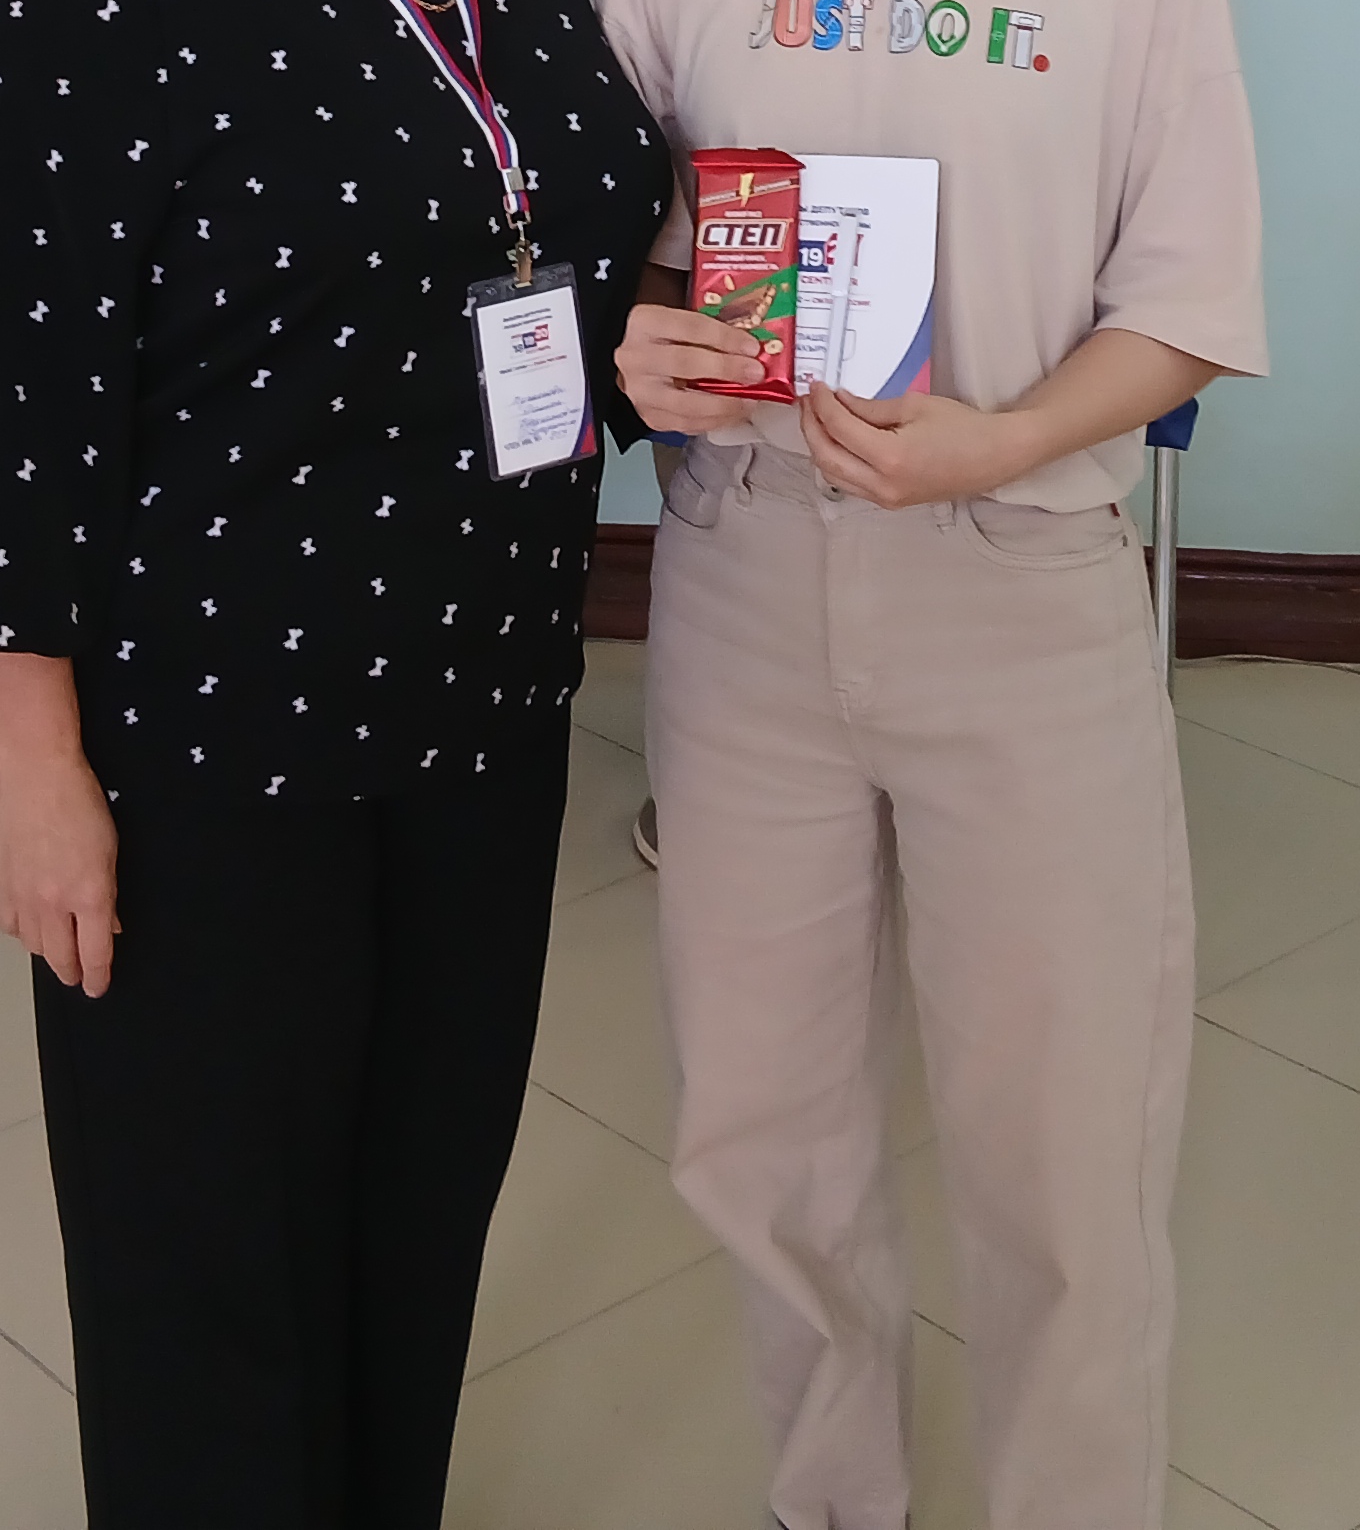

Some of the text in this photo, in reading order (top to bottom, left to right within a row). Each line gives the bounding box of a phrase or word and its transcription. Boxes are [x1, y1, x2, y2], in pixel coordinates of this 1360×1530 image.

[986, 6, 1051, 73] IT.
[702, 223, 782, 246] СТЕП
[798, 247, 824, 267] 19
